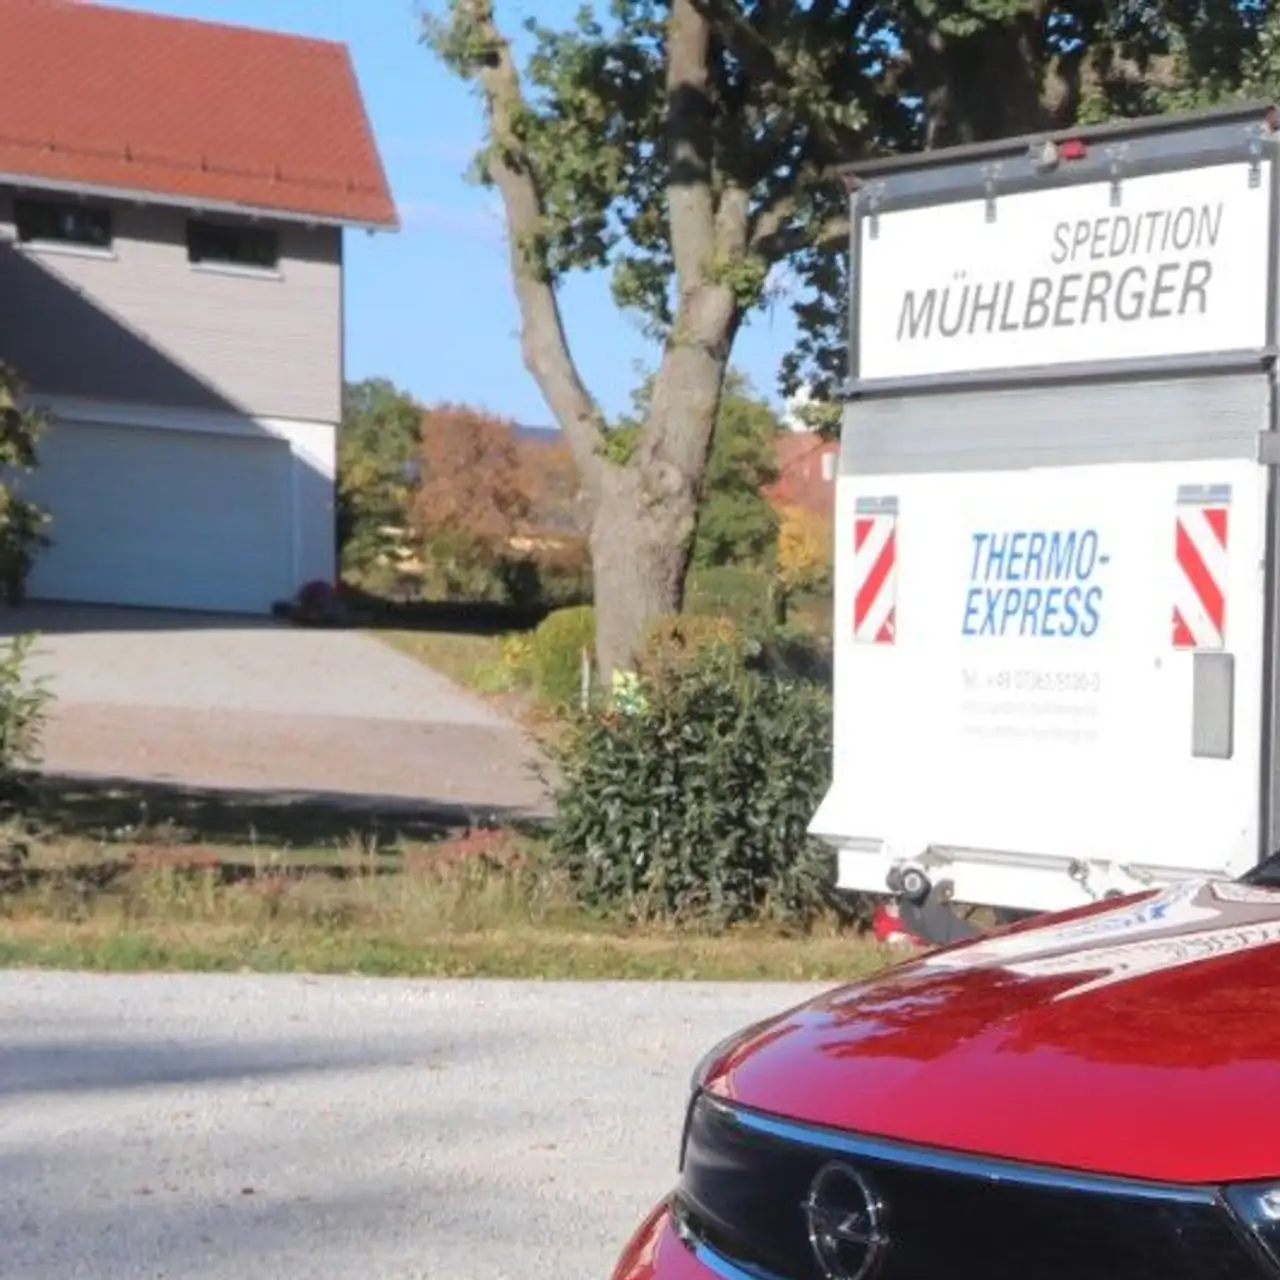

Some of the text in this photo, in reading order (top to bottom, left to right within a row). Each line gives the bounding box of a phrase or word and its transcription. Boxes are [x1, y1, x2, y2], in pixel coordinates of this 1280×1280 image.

[1051, 203, 1223, 264] SPEDITION
[896, 259, 1213, 340] MÜHLBERGER
[969, 529, 1111, 583] THERMO-
[961, 585, 1103, 638] EXPRESS
